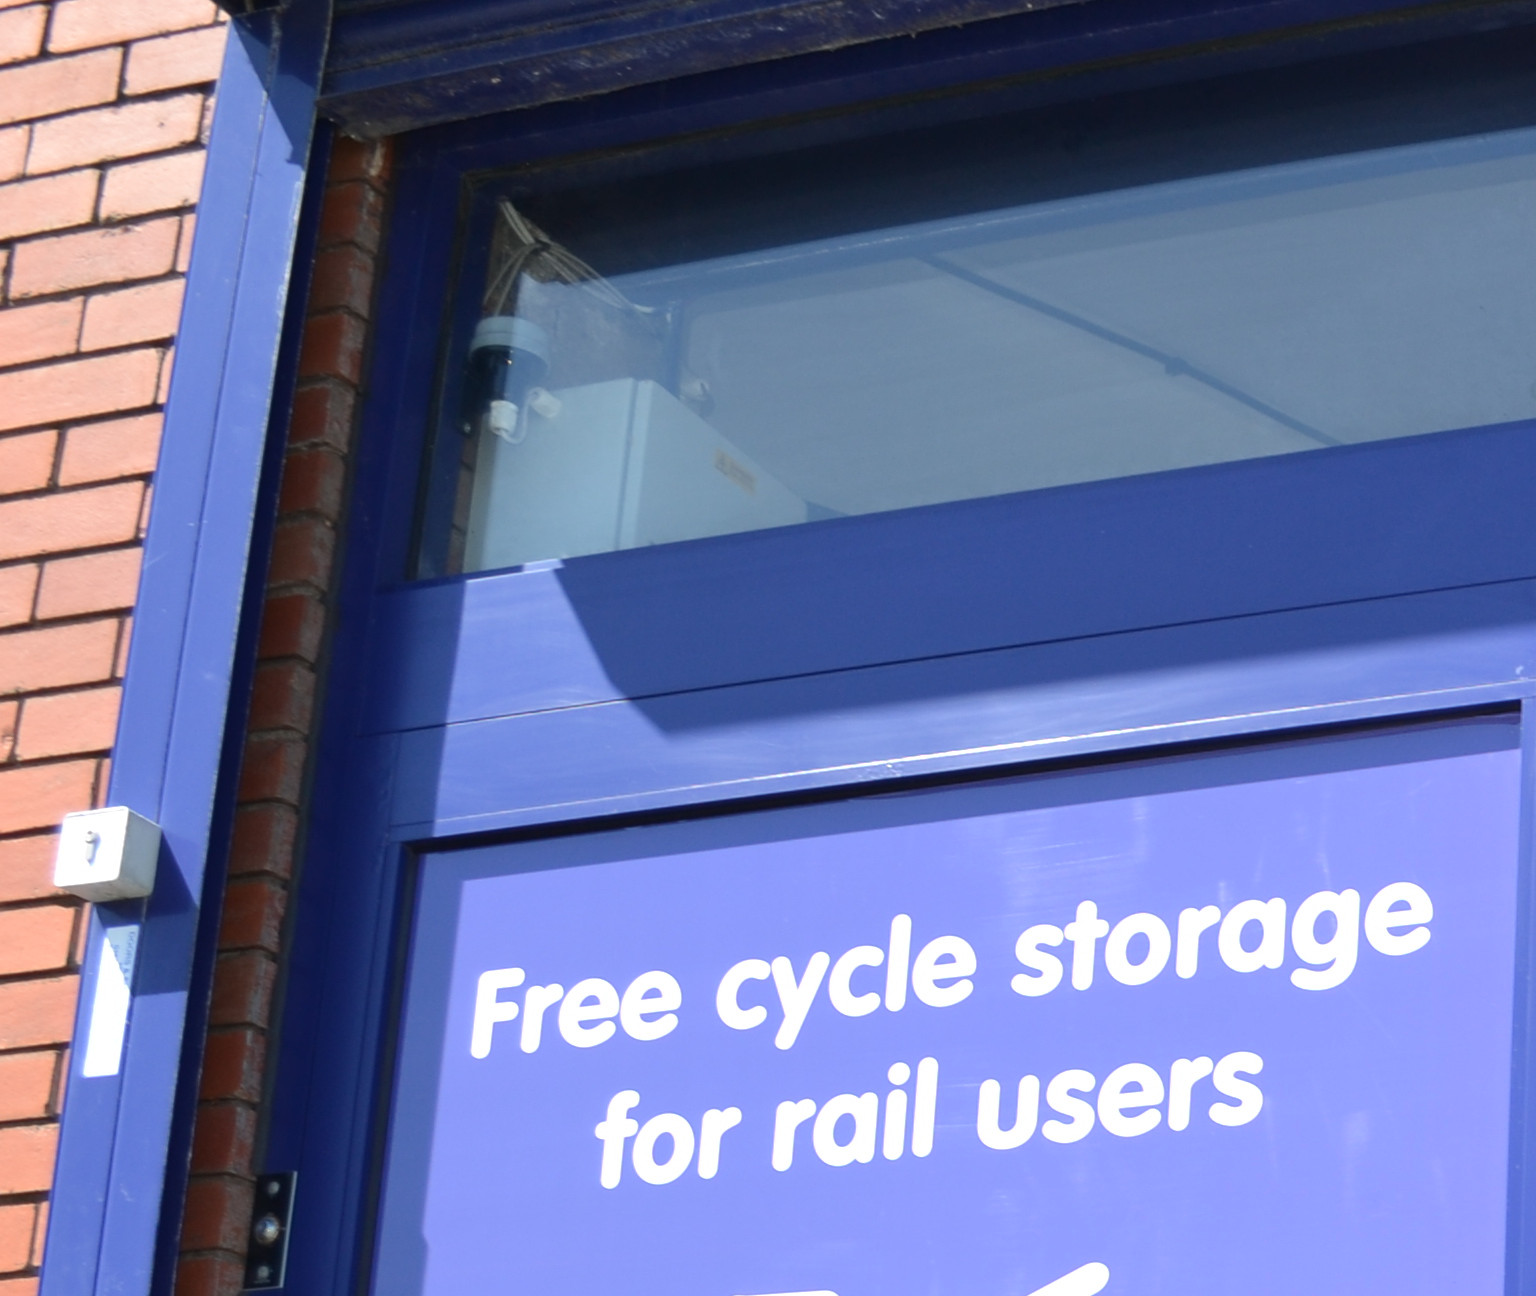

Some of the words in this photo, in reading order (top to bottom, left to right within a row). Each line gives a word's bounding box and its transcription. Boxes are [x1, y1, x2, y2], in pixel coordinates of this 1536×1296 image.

[469, 967, 682, 1059] Free
[715, 914, 977, 1050] cycle
[1010, 882, 1434, 997] storage
[594, 1090, 742, 1189] for
[771, 1057, 939, 1171] rail
[976, 1051, 1268, 1150] users
